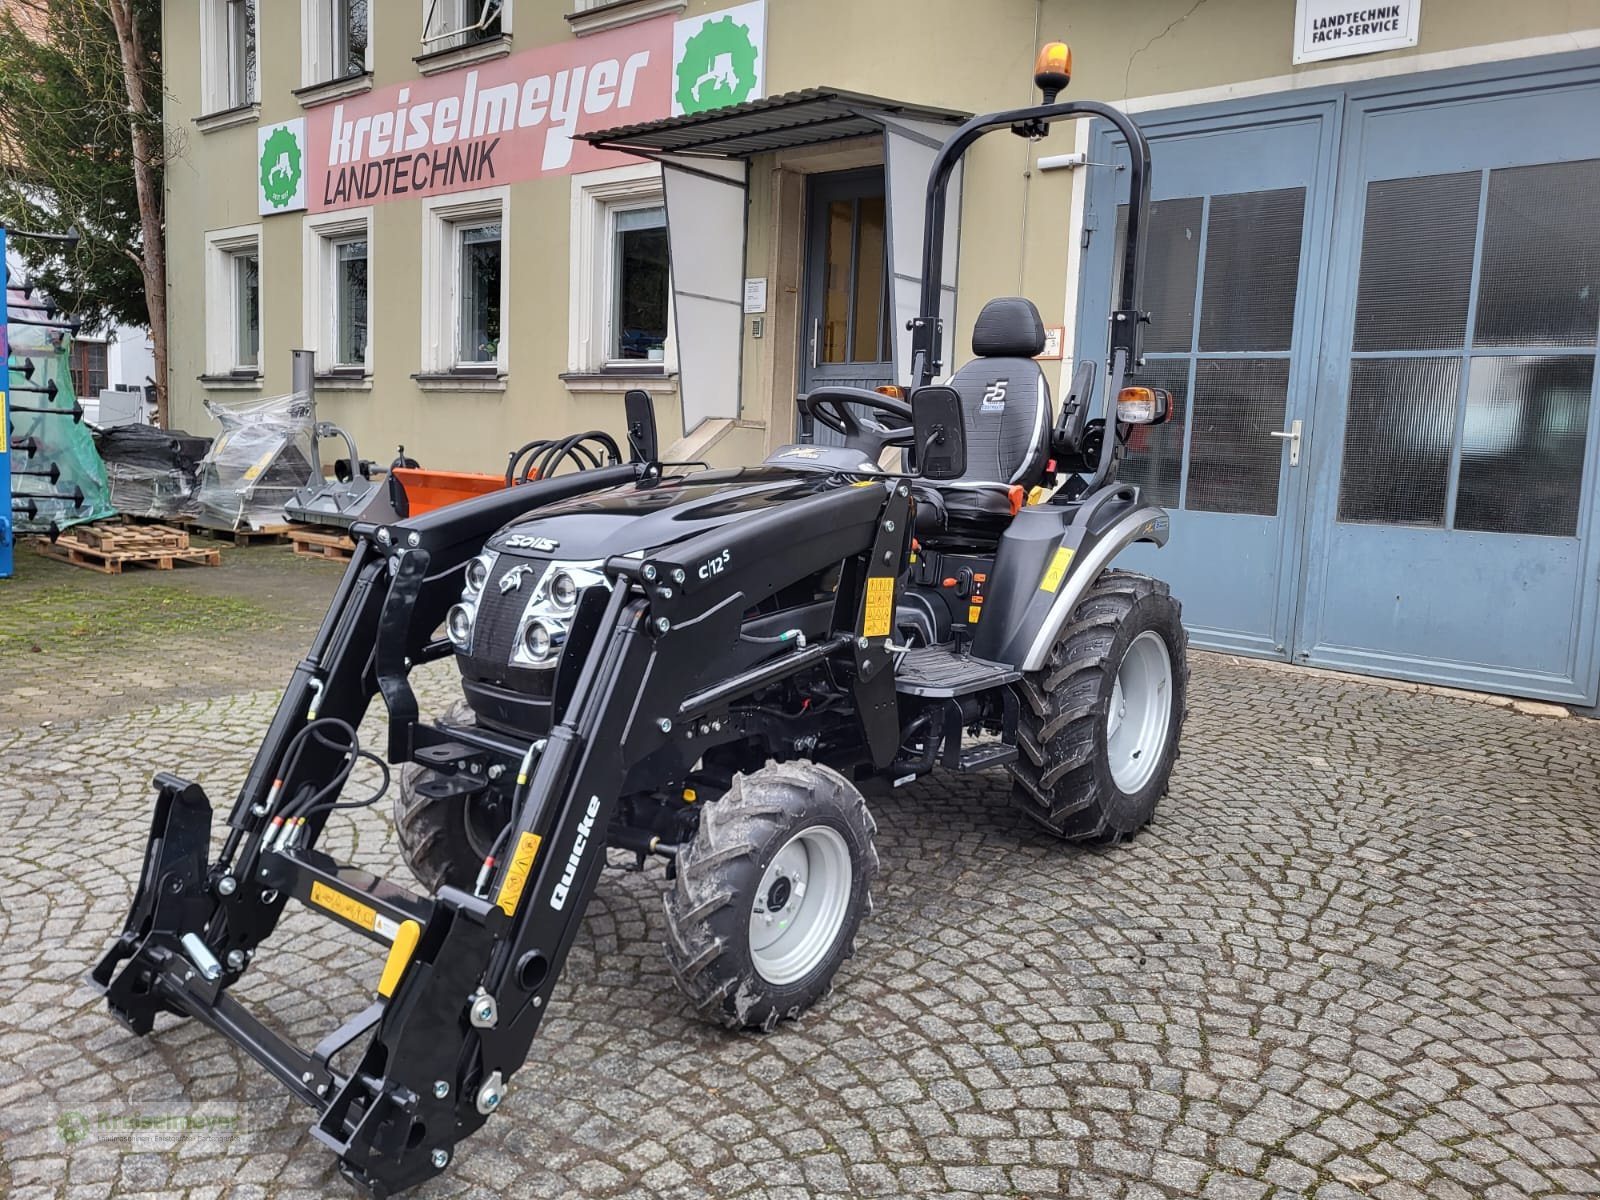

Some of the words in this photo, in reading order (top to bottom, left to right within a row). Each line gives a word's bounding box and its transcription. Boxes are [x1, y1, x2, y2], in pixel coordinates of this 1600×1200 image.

[1312, 19, 1399, 43] FACH-SERVICE
[1313, 5, 1400, 30] LANDTECHNIK
[328, 50, 650, 171] kreiselmeyer
[323, 137, 500, 205] LANDTECHNIK
[550, 795, 600, 910] Quicke
